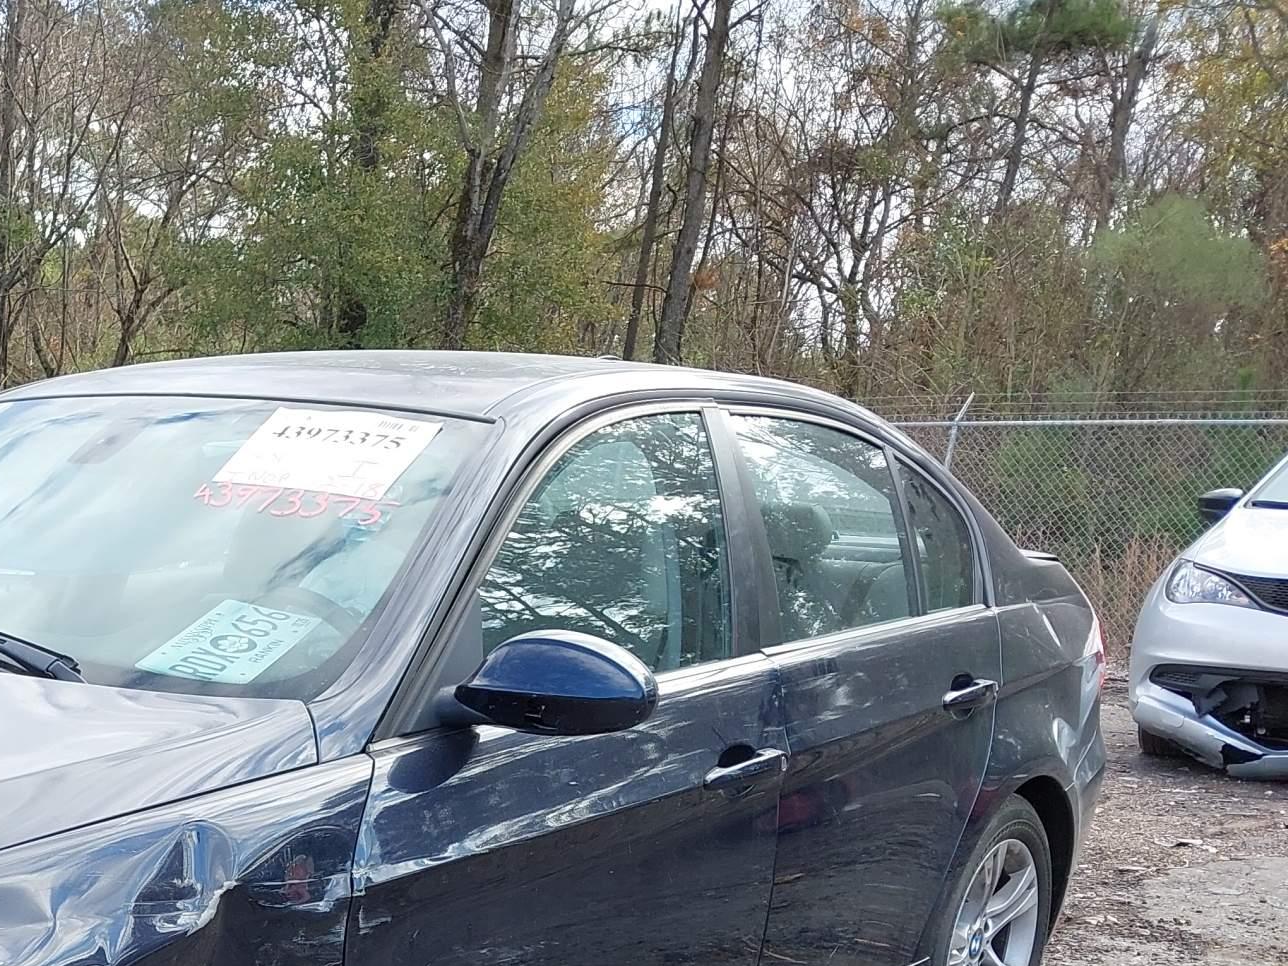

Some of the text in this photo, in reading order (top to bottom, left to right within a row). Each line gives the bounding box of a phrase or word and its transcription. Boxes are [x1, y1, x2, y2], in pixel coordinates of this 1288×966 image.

[271, 423, 408, 450] 43973375
[192, 480, 402, 526] 43973375
[168, 606, 291, 680] RDX 656
[248, 639, 285, 664] RANKIN
